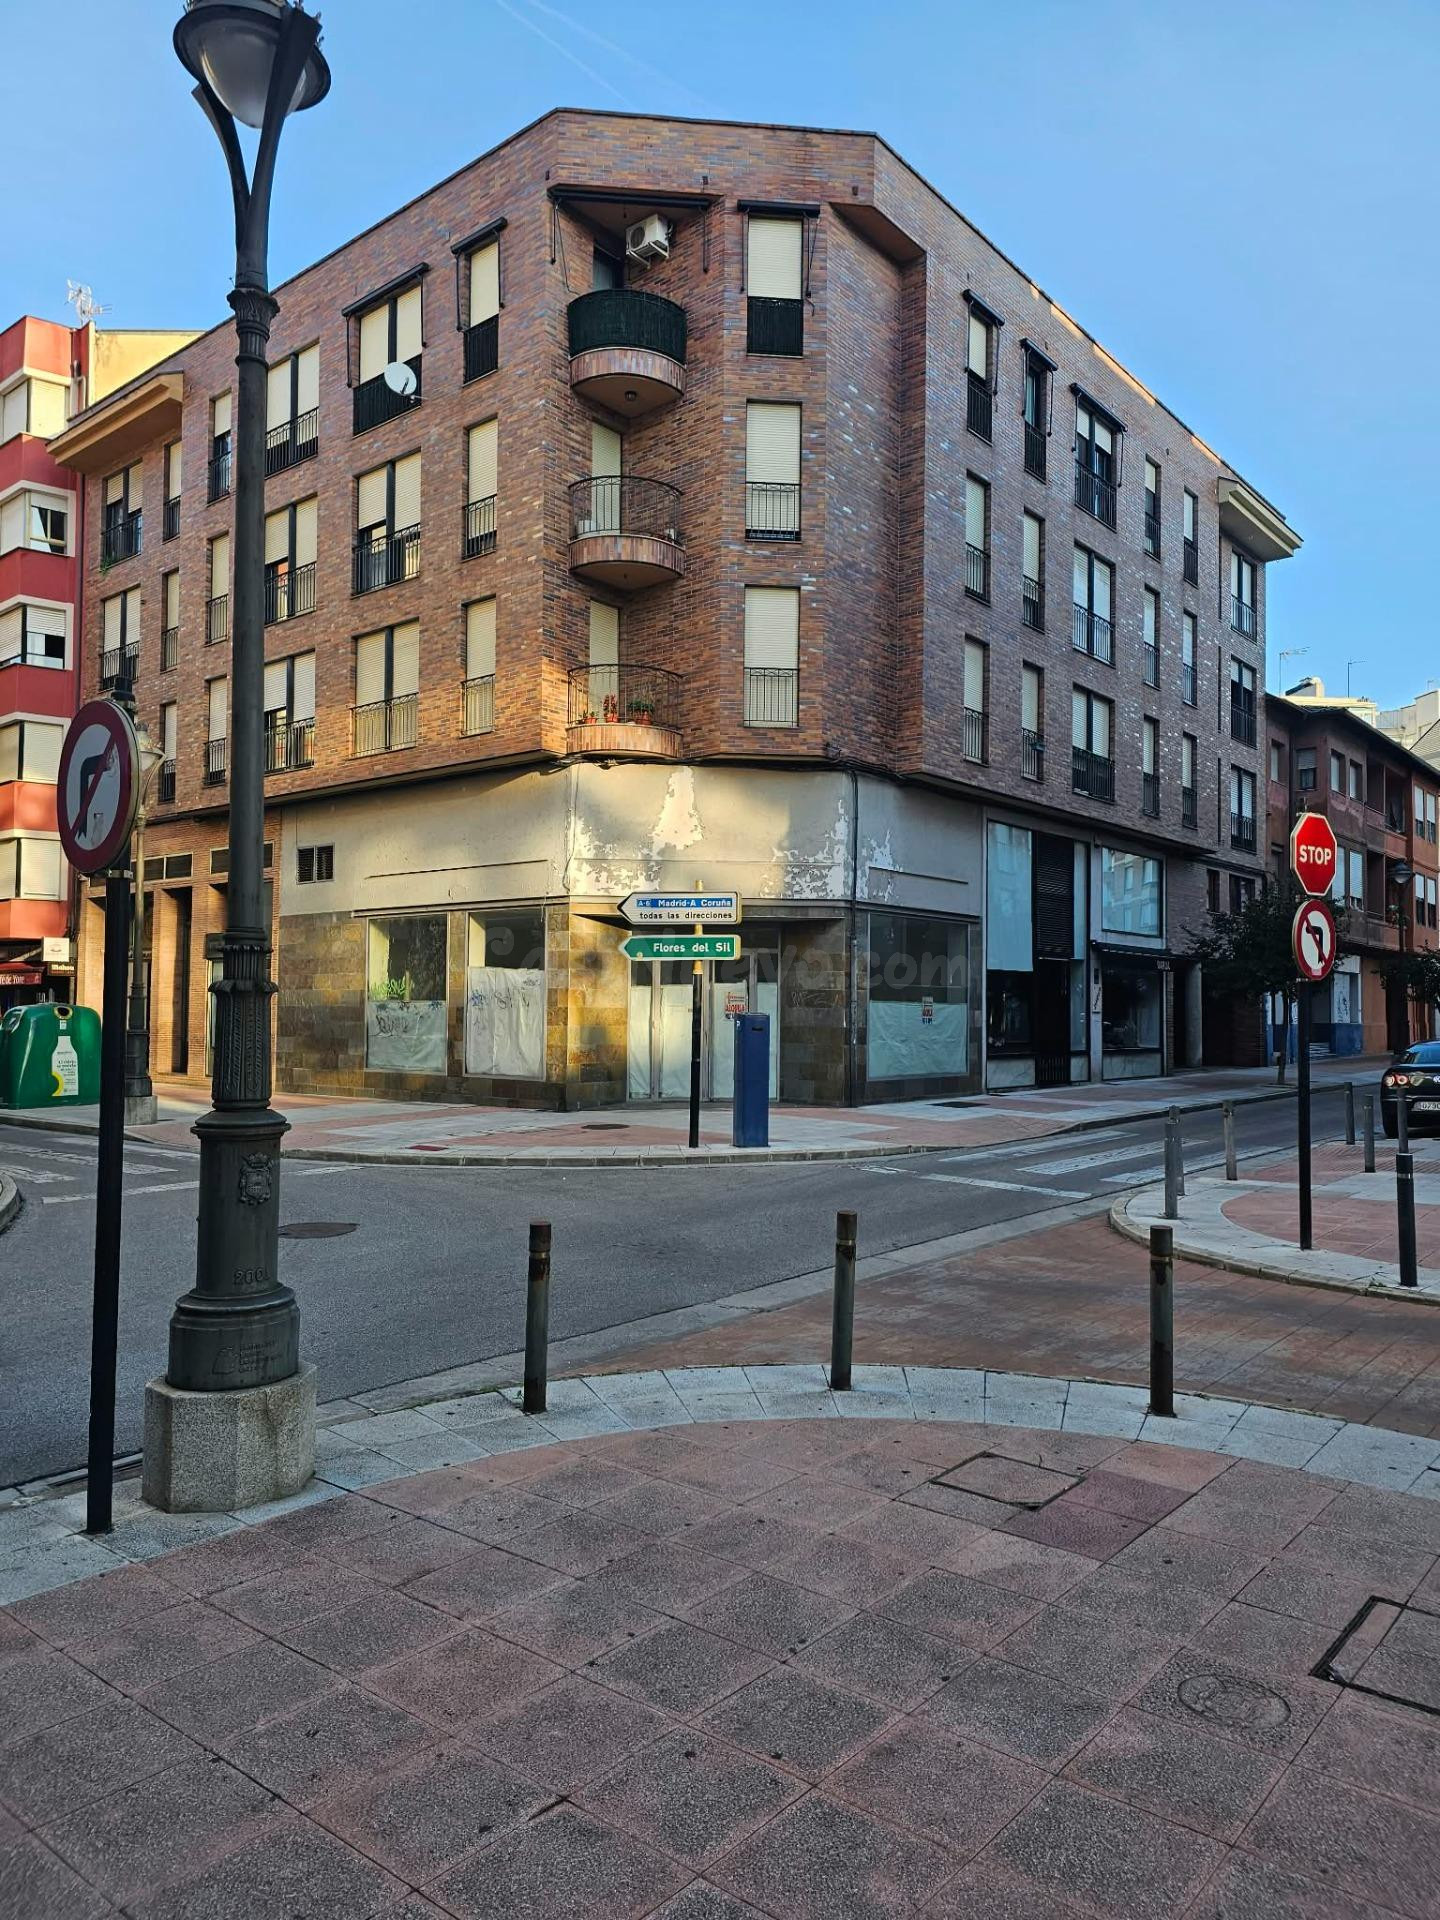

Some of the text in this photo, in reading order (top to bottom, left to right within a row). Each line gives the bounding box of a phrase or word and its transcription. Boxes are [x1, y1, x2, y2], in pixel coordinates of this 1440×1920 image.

[1298, 844, 1332, 866] STOP
[701, 899, 732, 907] Coruña
[640, 911, 733, 919] todas las direcciones
[653, 942, 731, 952] Flores del Sil
